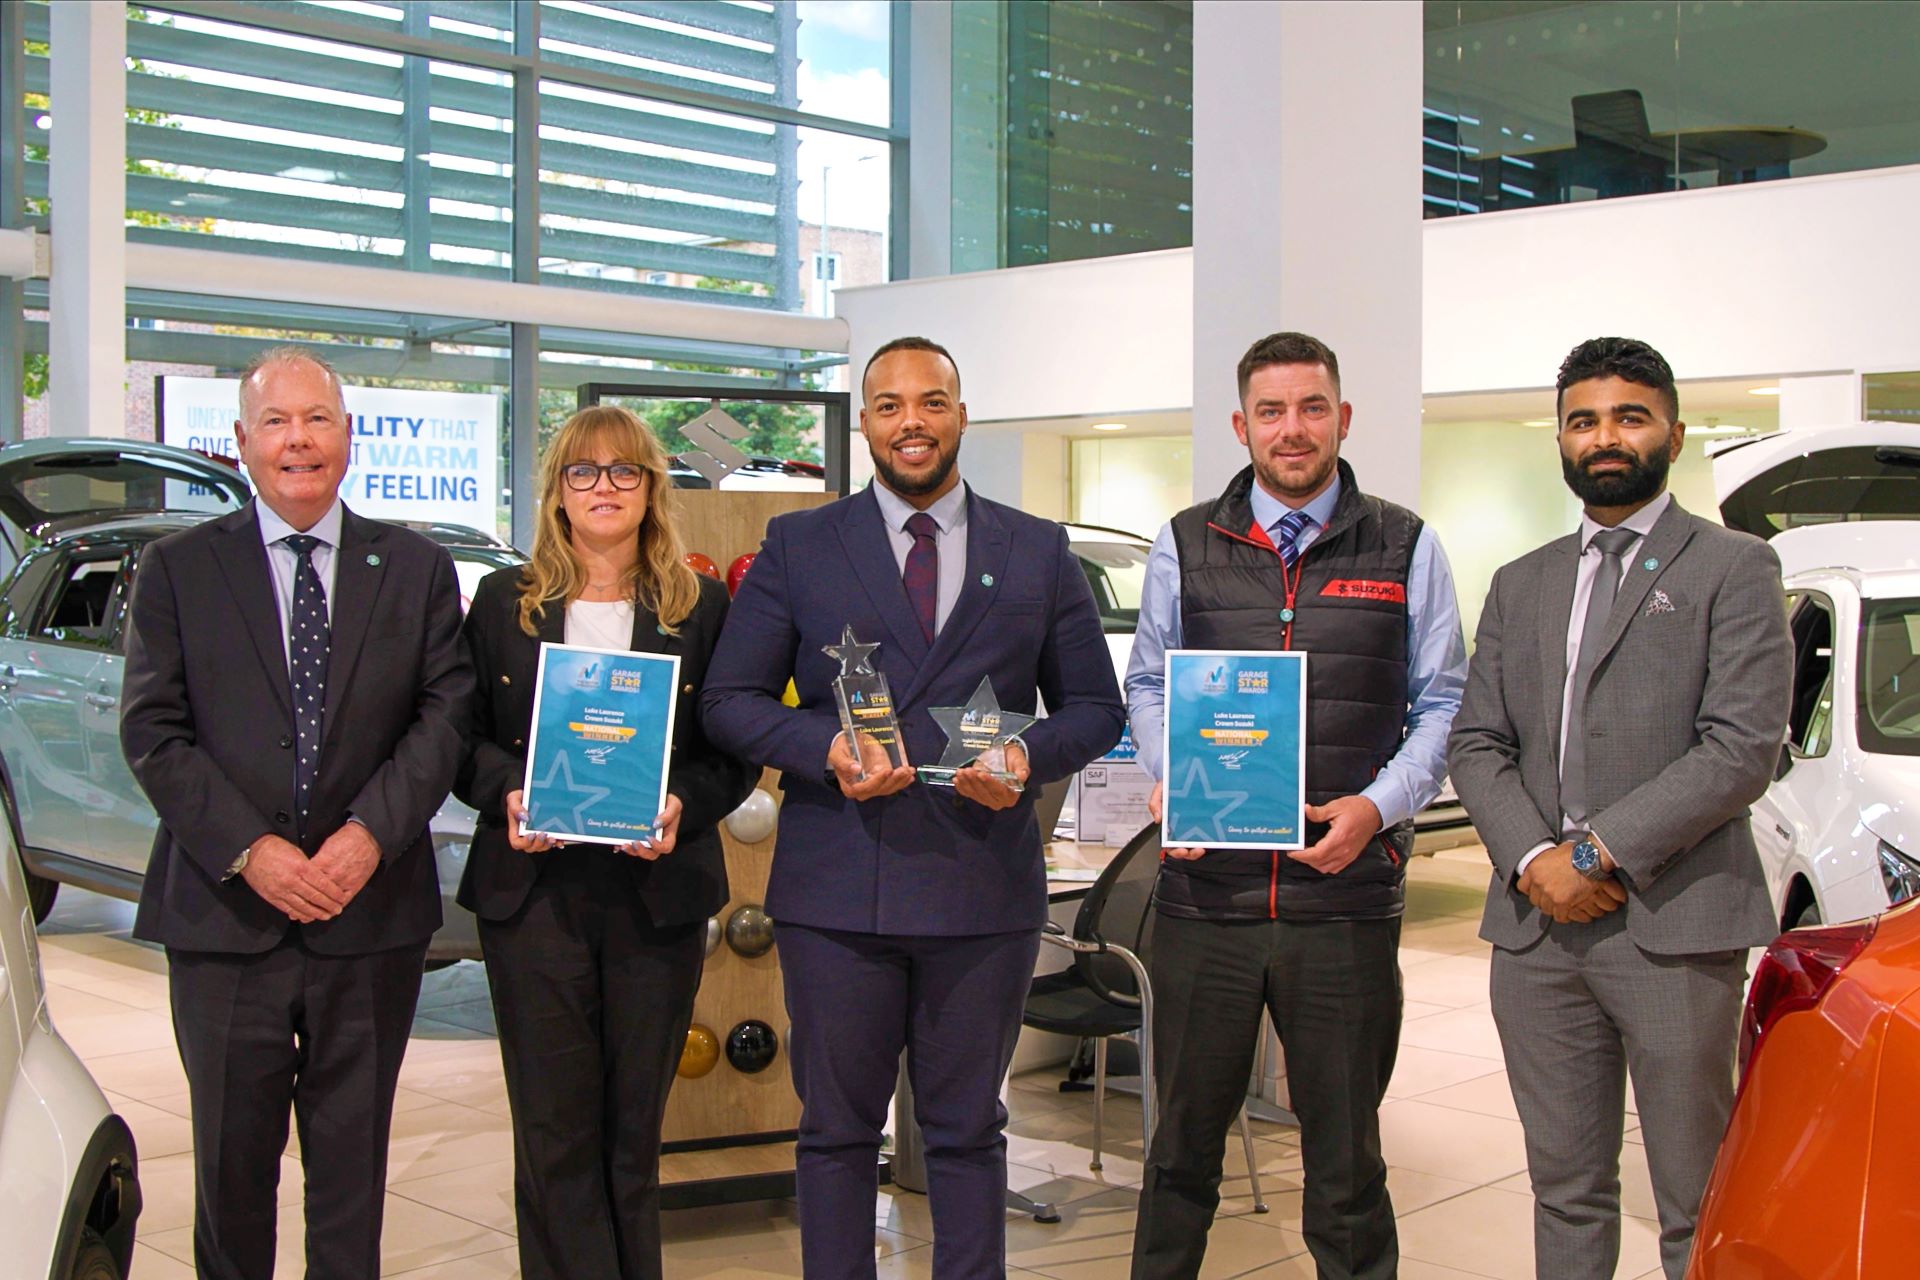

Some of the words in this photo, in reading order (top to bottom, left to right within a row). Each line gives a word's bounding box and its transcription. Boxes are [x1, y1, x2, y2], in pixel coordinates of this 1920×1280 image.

[428, 419, 478, 441] THAT
[367, 443, 478, 470] WARM
[365, 474, 477, 501] FEELING
[1352, 584, 1396, 596] SUZUKI
[1238, 670, 1268, 679] GARAGE
[1214, 729, 1252, 738] NATIONAL
[1087, 770, 1105, 779] SAF
